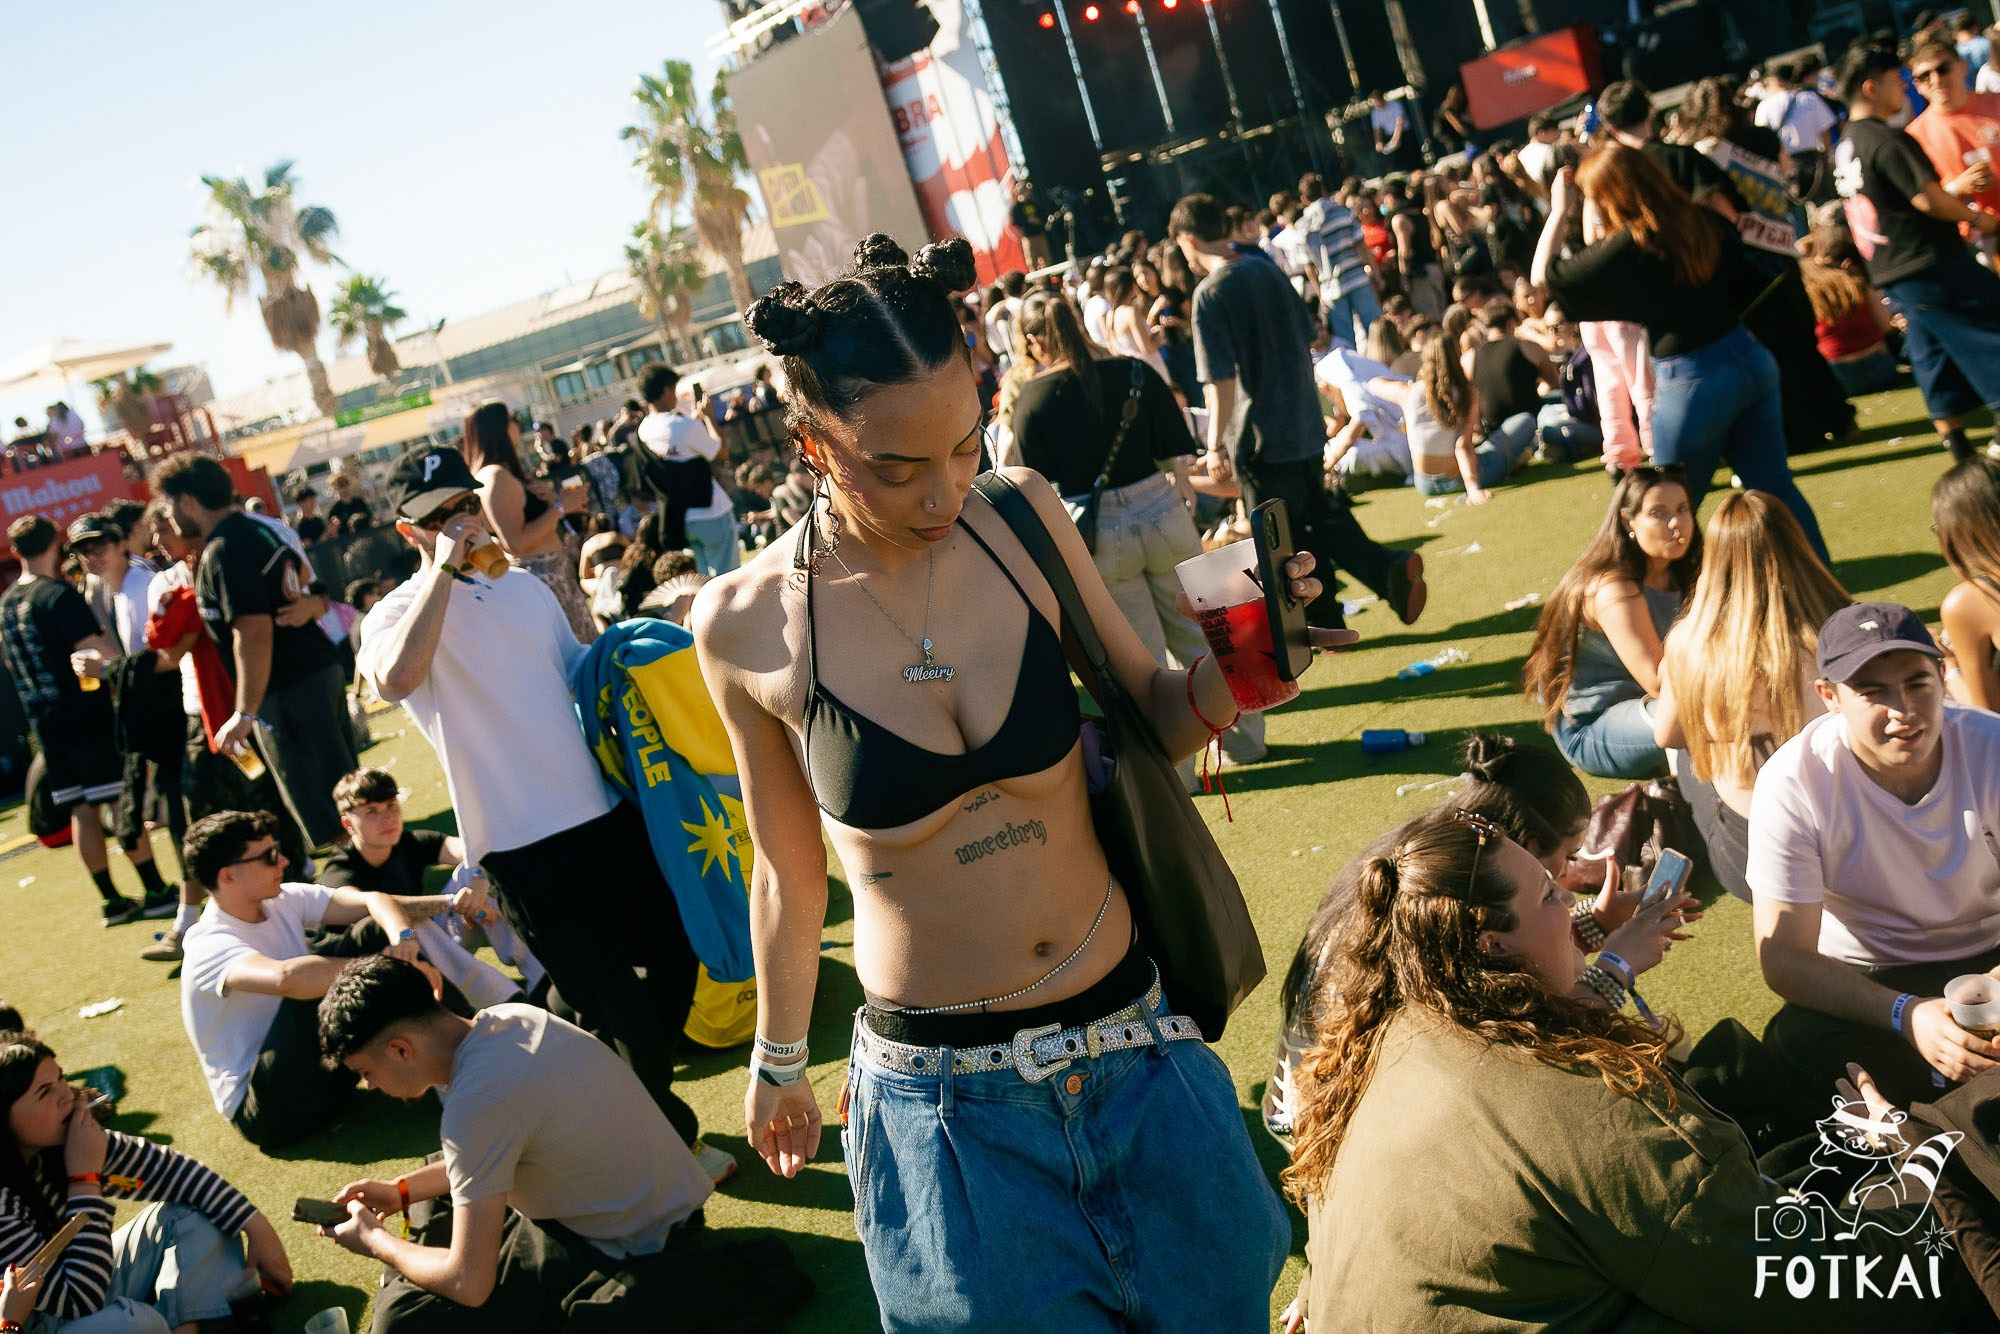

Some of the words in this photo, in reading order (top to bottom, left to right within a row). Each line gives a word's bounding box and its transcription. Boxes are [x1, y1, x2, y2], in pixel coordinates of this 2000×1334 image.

[424, 454, 442, 482] P
[2, 474, 103, 515] Mahou
[904, 666, 957, 683] Meeiry
[622, 680, 672, 788] EOPLE
[954, 819, 1048, 864] meeiry
